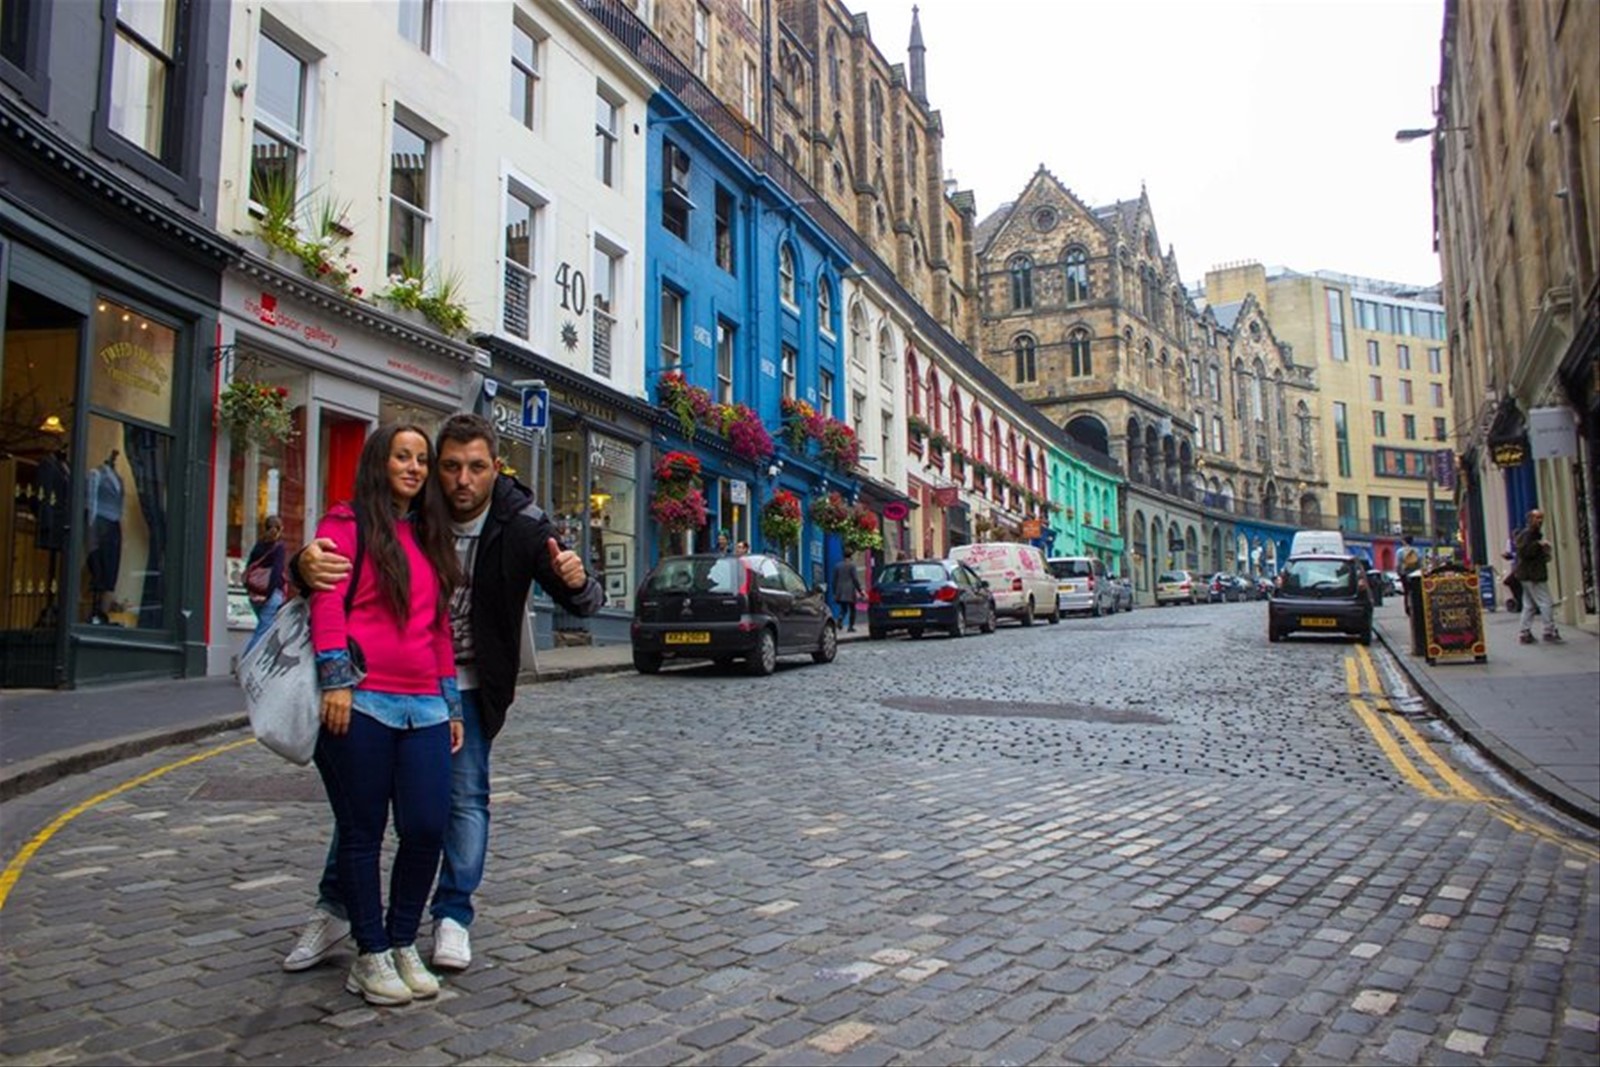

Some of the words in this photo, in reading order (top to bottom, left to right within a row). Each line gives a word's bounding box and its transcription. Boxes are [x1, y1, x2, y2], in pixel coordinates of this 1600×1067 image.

[555, 262, 586, 316] 40
[277, 311, 301, 331] door
[304, 325, 338, 348] gallery
